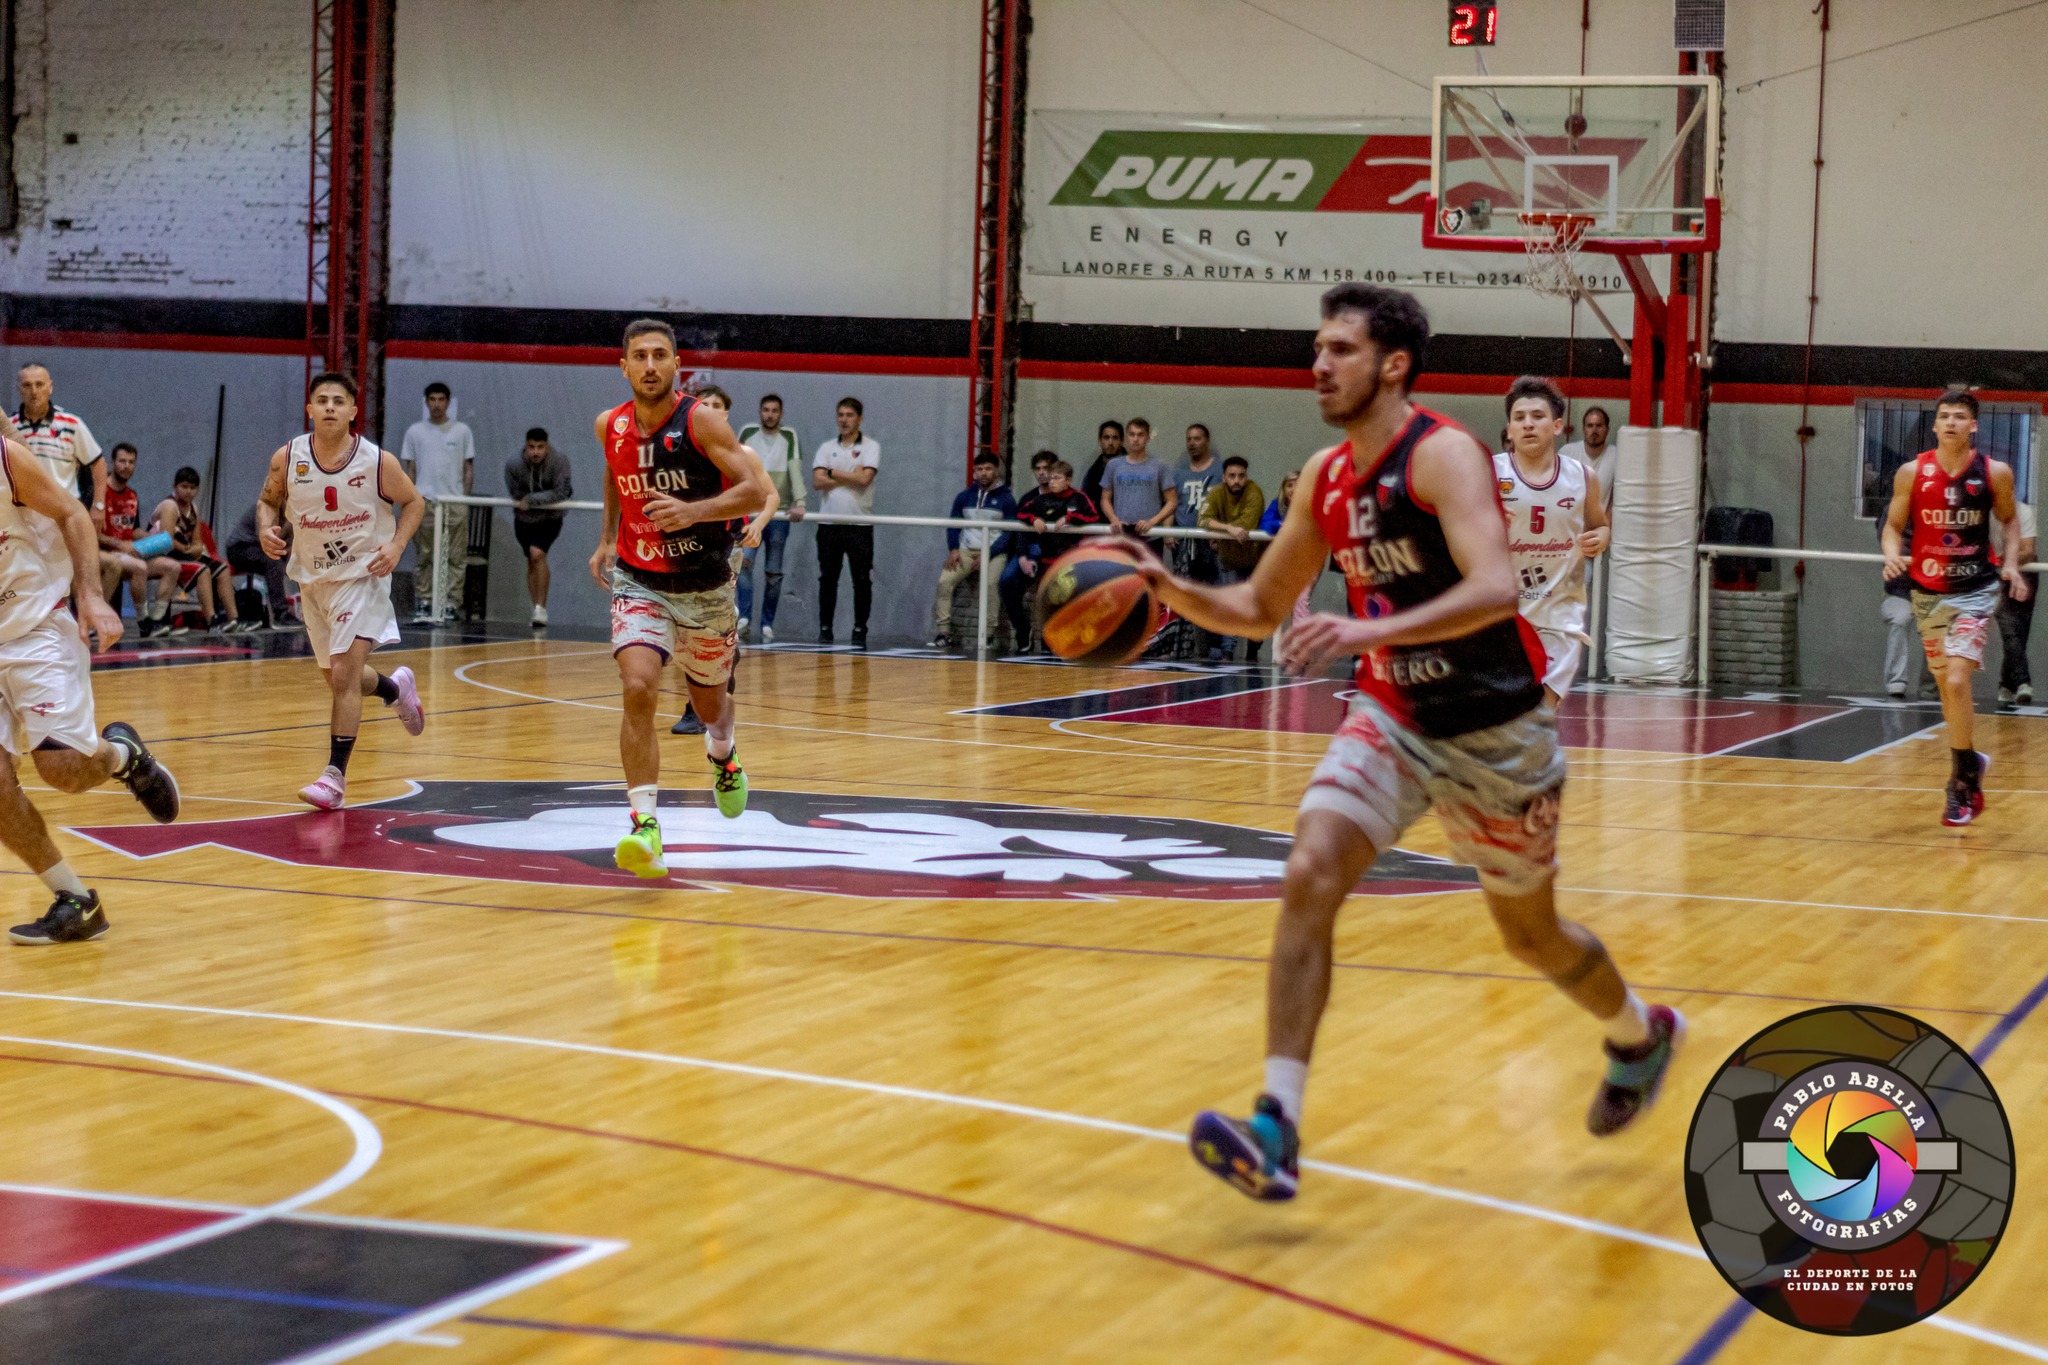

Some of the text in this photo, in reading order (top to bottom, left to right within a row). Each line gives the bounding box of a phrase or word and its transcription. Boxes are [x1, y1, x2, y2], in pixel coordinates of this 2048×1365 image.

[1450, 8, 1497, 45] 21
[1091, 156, 1314, 202] PUMA
[1062, 261, 1153, 276] LANORFE
[1204, 265, 1255, 279] RUTA
[1264, 268, 1274, 281] 5
[1284, 268, 1312, 281] KM
[637, 443, 655, 469] 11
[324, 486, 338, 512] 9
[1944, 486, 1958, 505] 4
[299, 510, 371, 531] Independiente
[1347, 497, 1377, 539] 12
[1530, 506, 1545, 534] 5
[1509, 537, 1574, 555] dependiente
